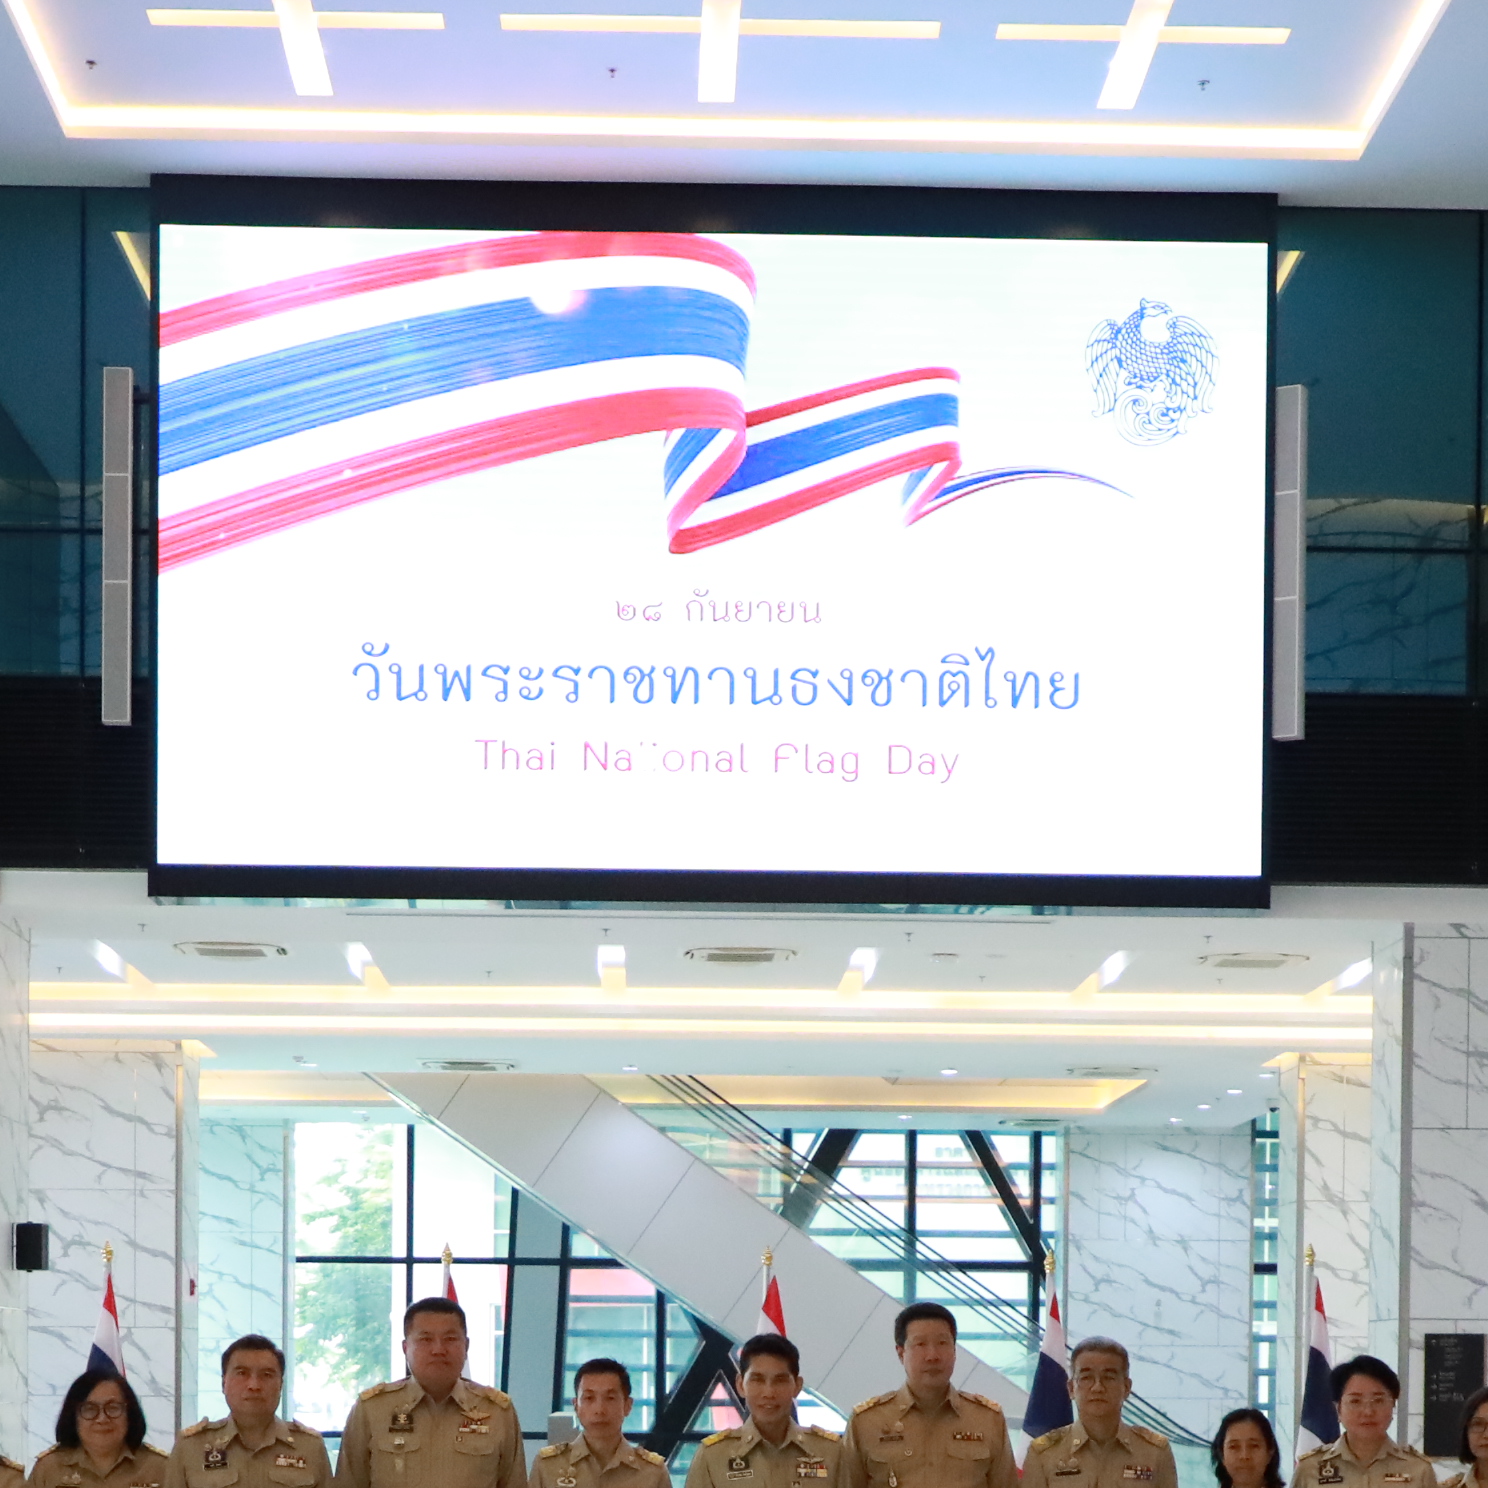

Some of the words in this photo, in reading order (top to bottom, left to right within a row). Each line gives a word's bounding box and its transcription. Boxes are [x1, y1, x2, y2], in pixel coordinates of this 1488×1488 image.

[615, 600, 663, 622] ๒๘
[685, 588, 822, 624] กันยายน
[351, 641, 1080, 710] วันพระราชทานธงชาติไทย
[474, 739, 556, 771] Thai
[583, 740, 749, 773] Naonal
[774, 742, 859, 783] Flag
[887, 744, 959, 784] Day
